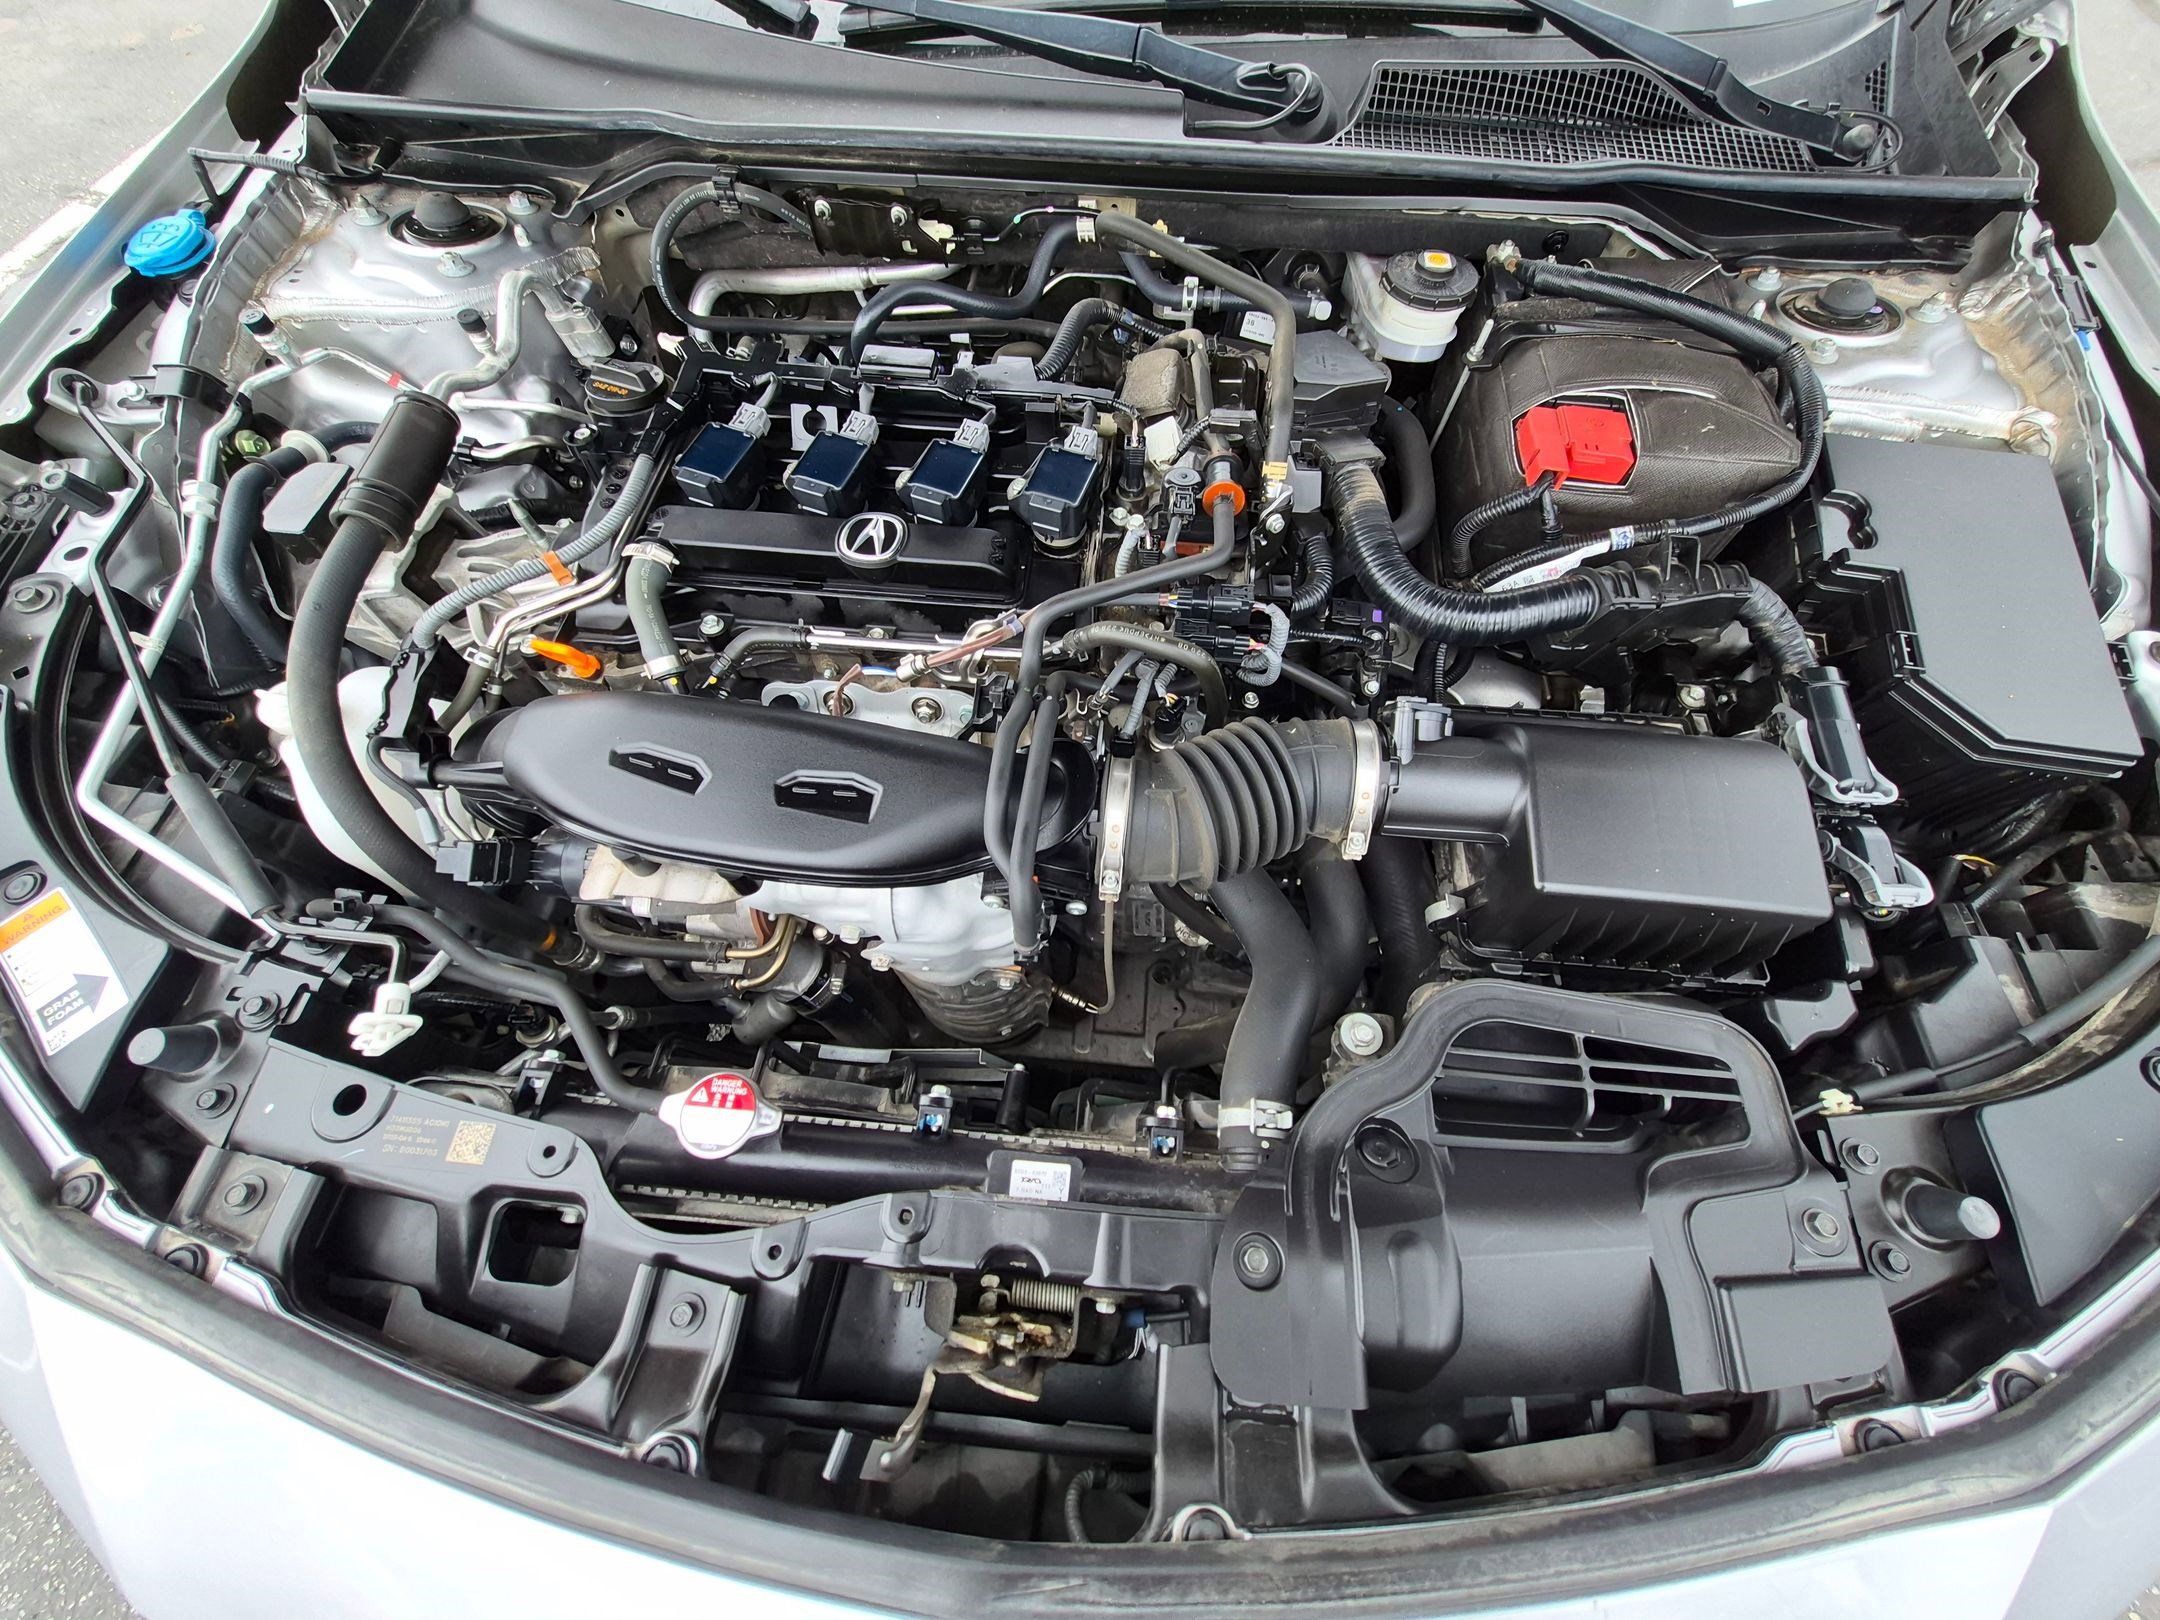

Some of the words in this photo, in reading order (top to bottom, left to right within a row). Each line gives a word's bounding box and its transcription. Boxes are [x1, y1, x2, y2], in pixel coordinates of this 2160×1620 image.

[1, 905, 63, 946] WARNING
[43, 989, 81, 1017] GRAB
[47, 997, 85, 1026] FOAM
[712, 1078, 743, 1088] DANGER
